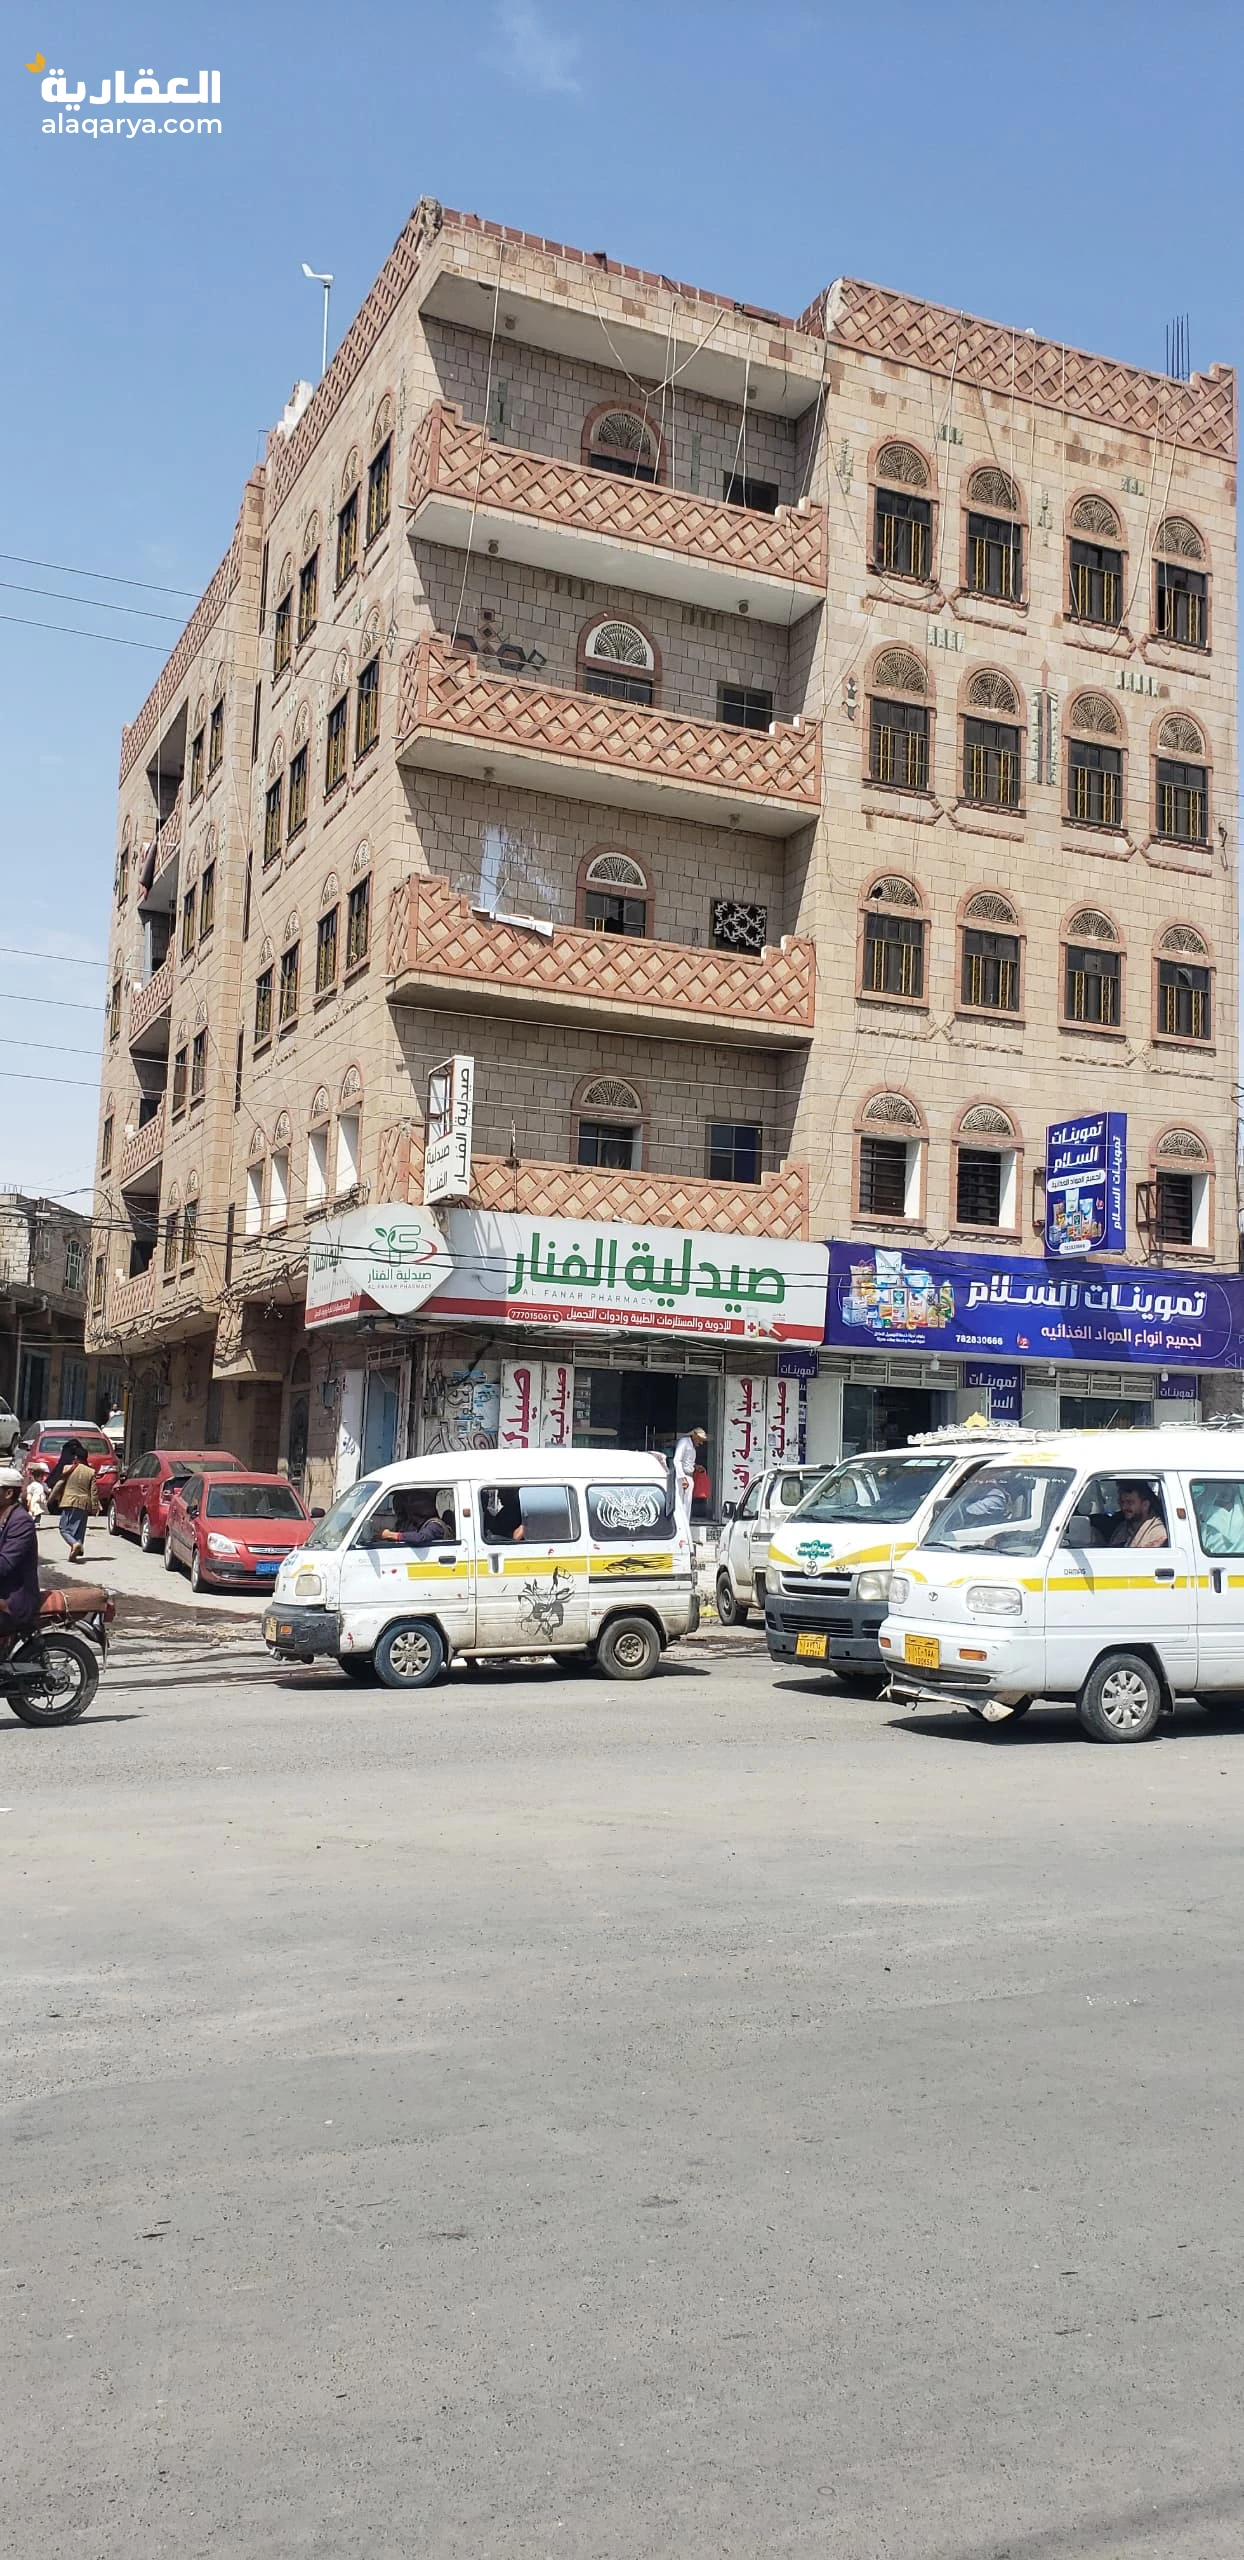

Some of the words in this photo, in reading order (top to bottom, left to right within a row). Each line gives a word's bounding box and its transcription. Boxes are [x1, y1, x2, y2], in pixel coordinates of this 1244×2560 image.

[454, 1068, 472, 1128] صيدلية
[1052, 1121, 1104, 1144] تموينات
[427, 1144, 450, 1168] صيدلية
[454, 1132, 467, 1185] الفنار
[1054, 1146, 1099, 1173] السلام
[1112, 1136, 1122, 1184] تموينات
[1112, 1187, 1122, 1231] السلام
[396, 1267, 432, 1283] صيدلية
[508, 1232, 618, 1295] الفنار
[368, 1267, 393, 1284] الفنار
[624, 1238, 785, 1313] صيدلية
[523, 1288, 537, 1296] AL
[544, 1289, 583, 1300] FANAR
[591, 1293, 654, 1305] PHARMACY
[965, 1274, 1078, 1308] السلام
[1084, 1283, 1207, 1321] تموينات
[511, 1310, 551, 1321] 777015061
[566, 1307, 598, 1321] التجميل
[630, 1312, 655, 1326] الطبية
[1095, 1327, 1132, 1343] المواد
[1135, 1331, 1163, 1347] انواع
[1165, 1333, 1202, 1350] لجميع
[780, 1363, 815, 1377] تموينات
[969, 1372, 1019, 1391] تموينات
[731, 1378, 759, 1460] صيدلية
